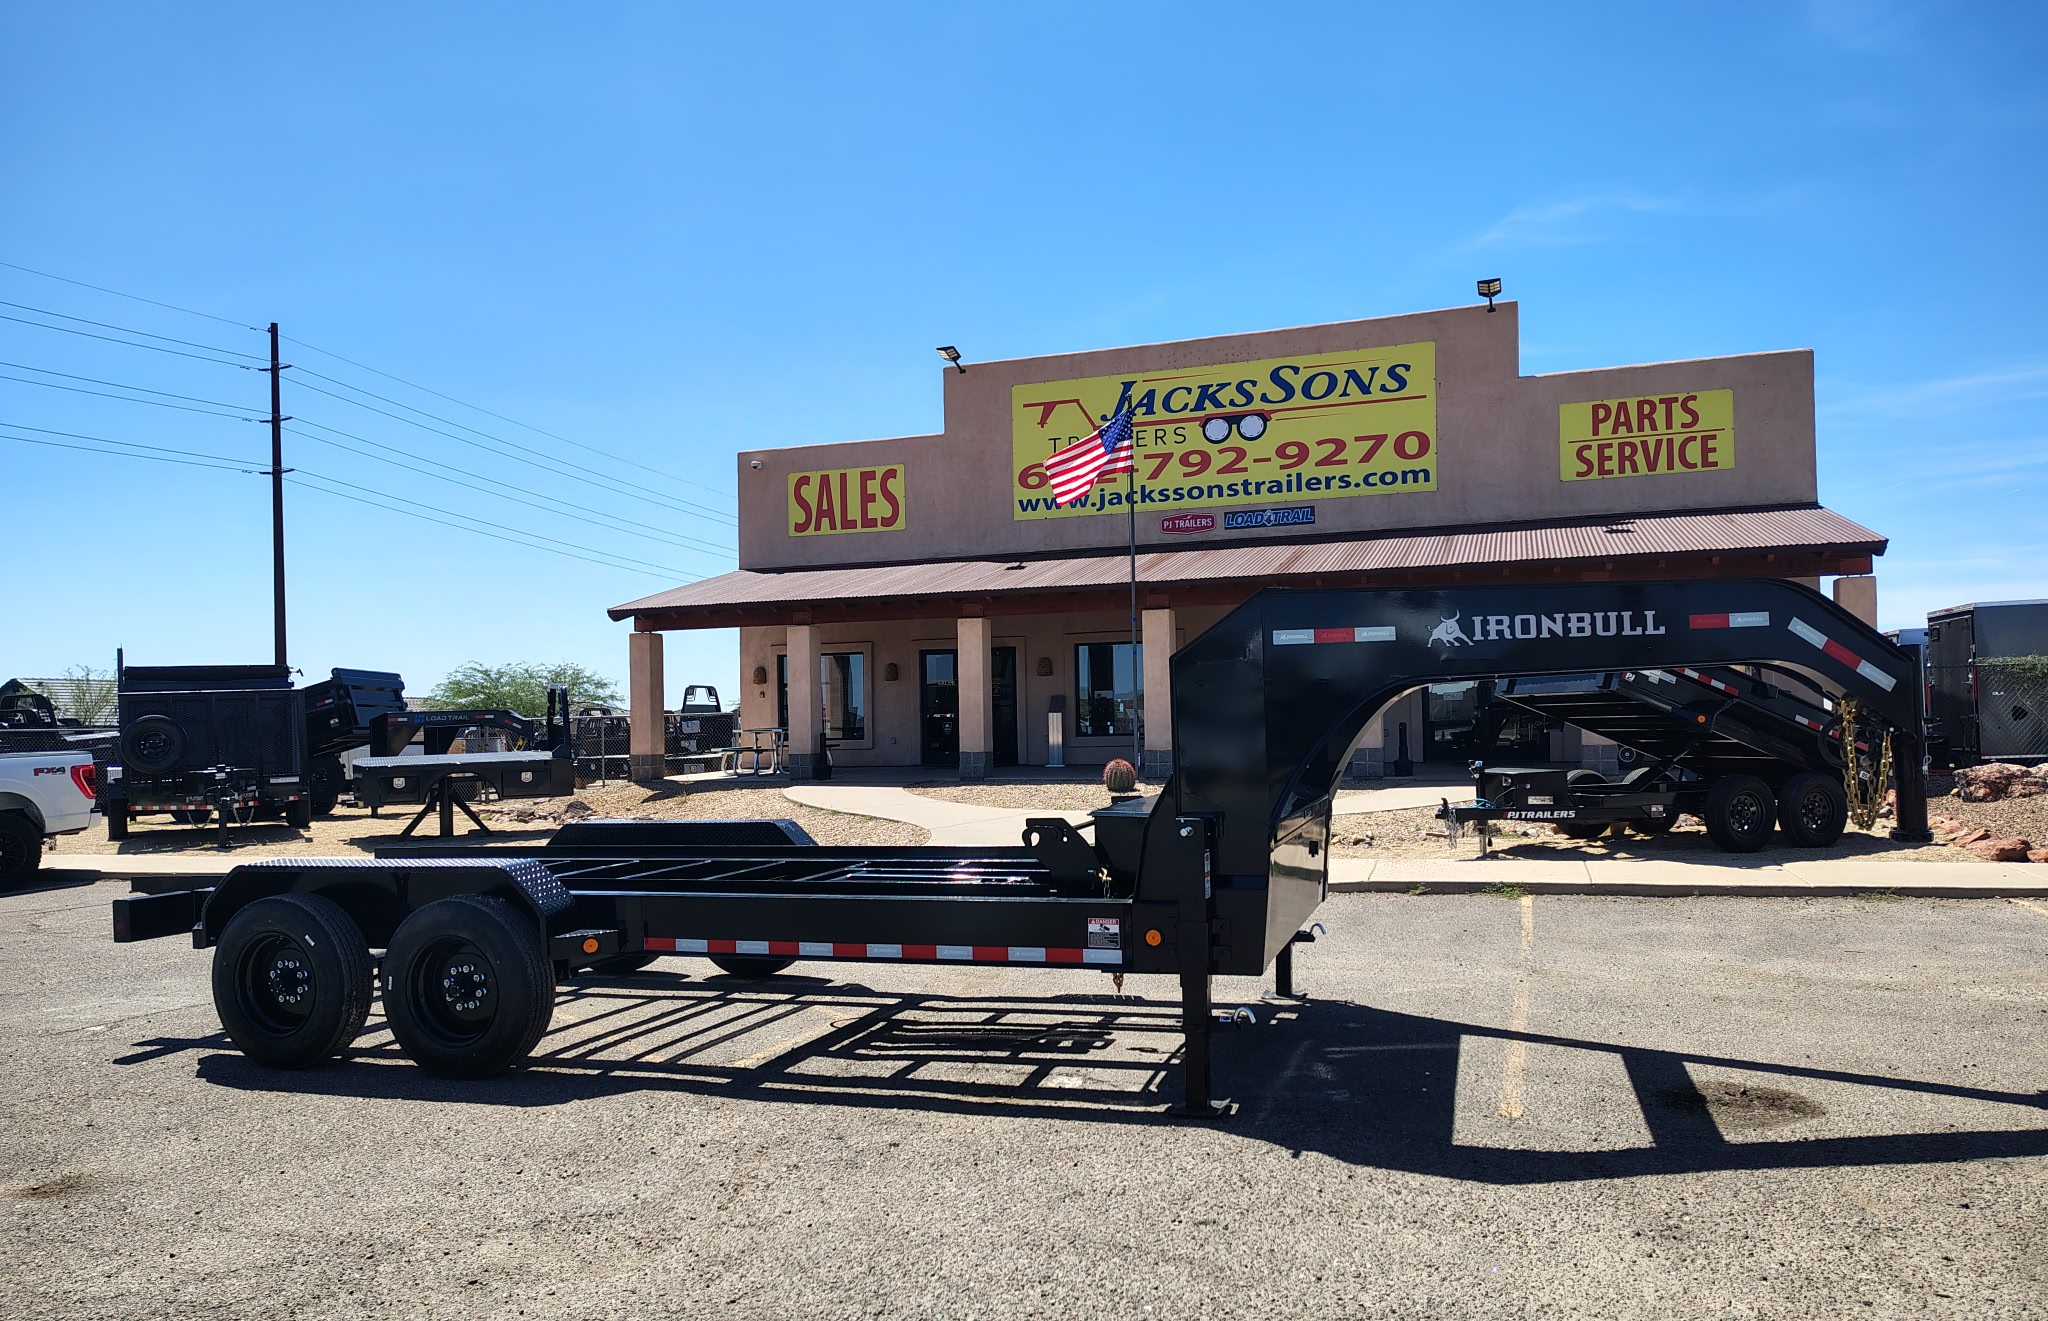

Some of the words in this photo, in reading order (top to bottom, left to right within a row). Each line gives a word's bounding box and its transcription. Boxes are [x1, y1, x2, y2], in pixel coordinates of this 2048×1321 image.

[1591, 395, 1700, 436] PARTS
[1017, 430, 1431, 490] 6-792-9270
[1575, 434, 1719, 478] SERVICE
[793, 468, 900, 533] SALES
[1225, 511, 1263, 528] LOAD
[1272, 508, 1315, 524] TRAIL
[1163, 520, 1172, 530] PJ
[1174, 517, 1213, 529] TRAILERS
[1471, 610, 1666, 641] IRONBULL
[1507, 811, 1520, 819] PJ
[1520, 810, 1576, 819] TRAILERS
